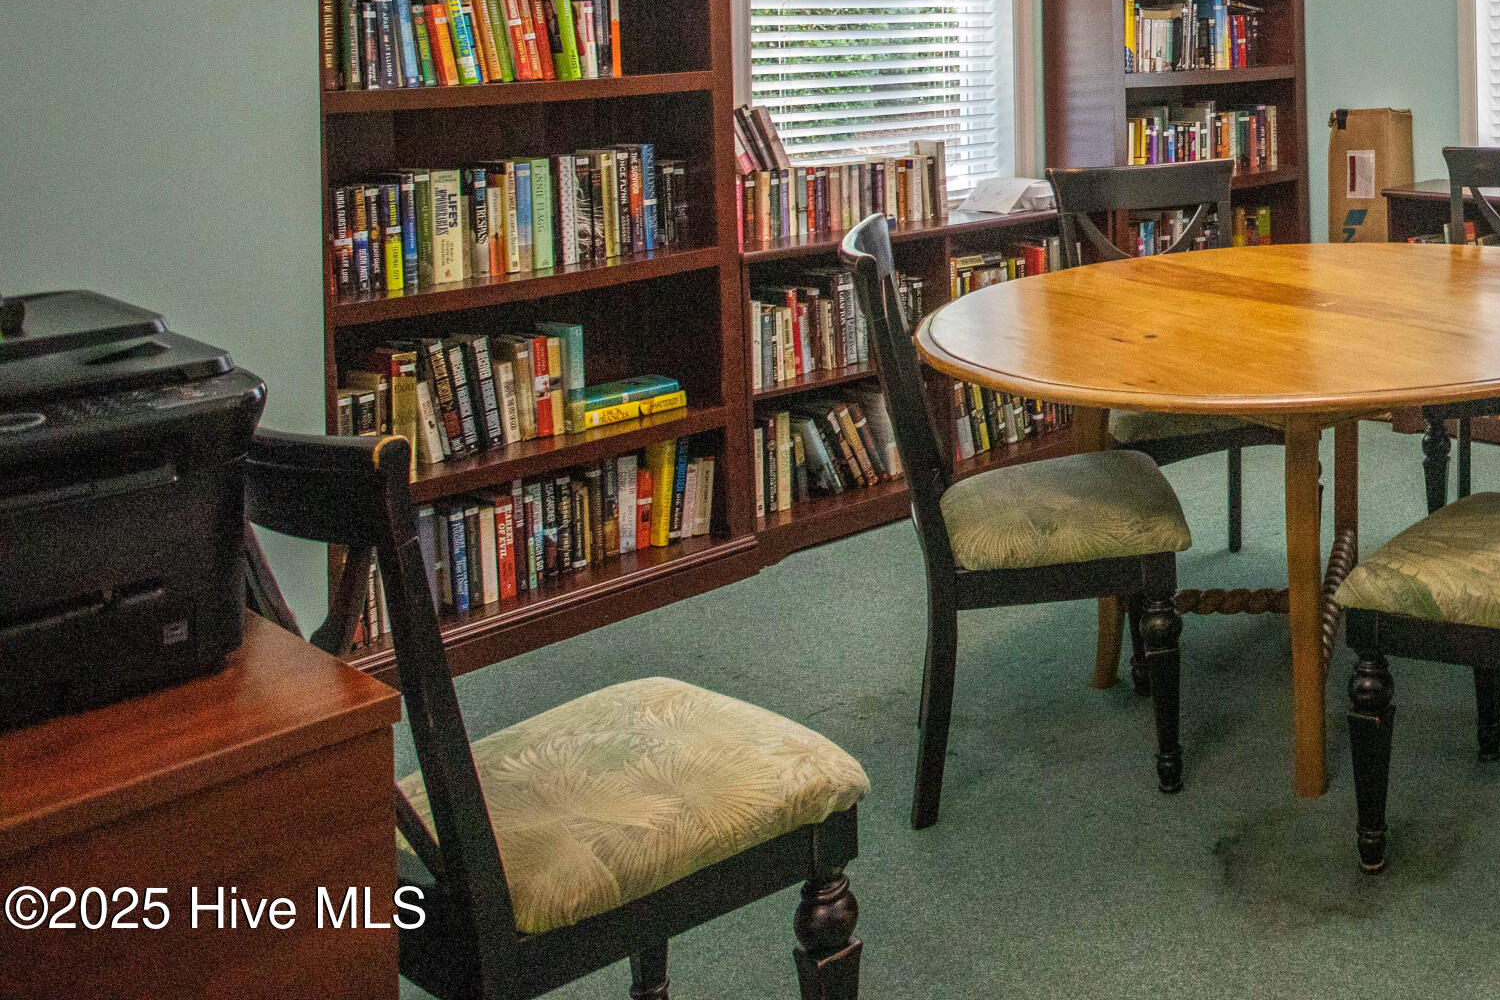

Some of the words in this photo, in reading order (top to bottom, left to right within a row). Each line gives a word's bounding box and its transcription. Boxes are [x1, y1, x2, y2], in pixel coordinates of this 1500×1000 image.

[452, 9, 470, 56] EVANOVICH
[385, 52, 393, 77] ELLISON
[630, 152, 638, 163] THE
[619, 179, 629, 204] FLYNN
[631, 165, 640, 194] SURVIVOR
[336, 191, 345, 209] LINDA
[355, 189, 364, 205] LINDA
[448, 193, 458, 228] LIFE'S
[535, 202, 545, 233] FLAGG
[337, 210, 347, 239] FAIRSTEIN
[475, 204, 488, 246] TRESPASS
[360, 265, 368, 282] ANGEL
[498, 523, 506, 536] OF
[504, 510, 514, 546] CAREER
[498, 537, 507, 559] EVIL
